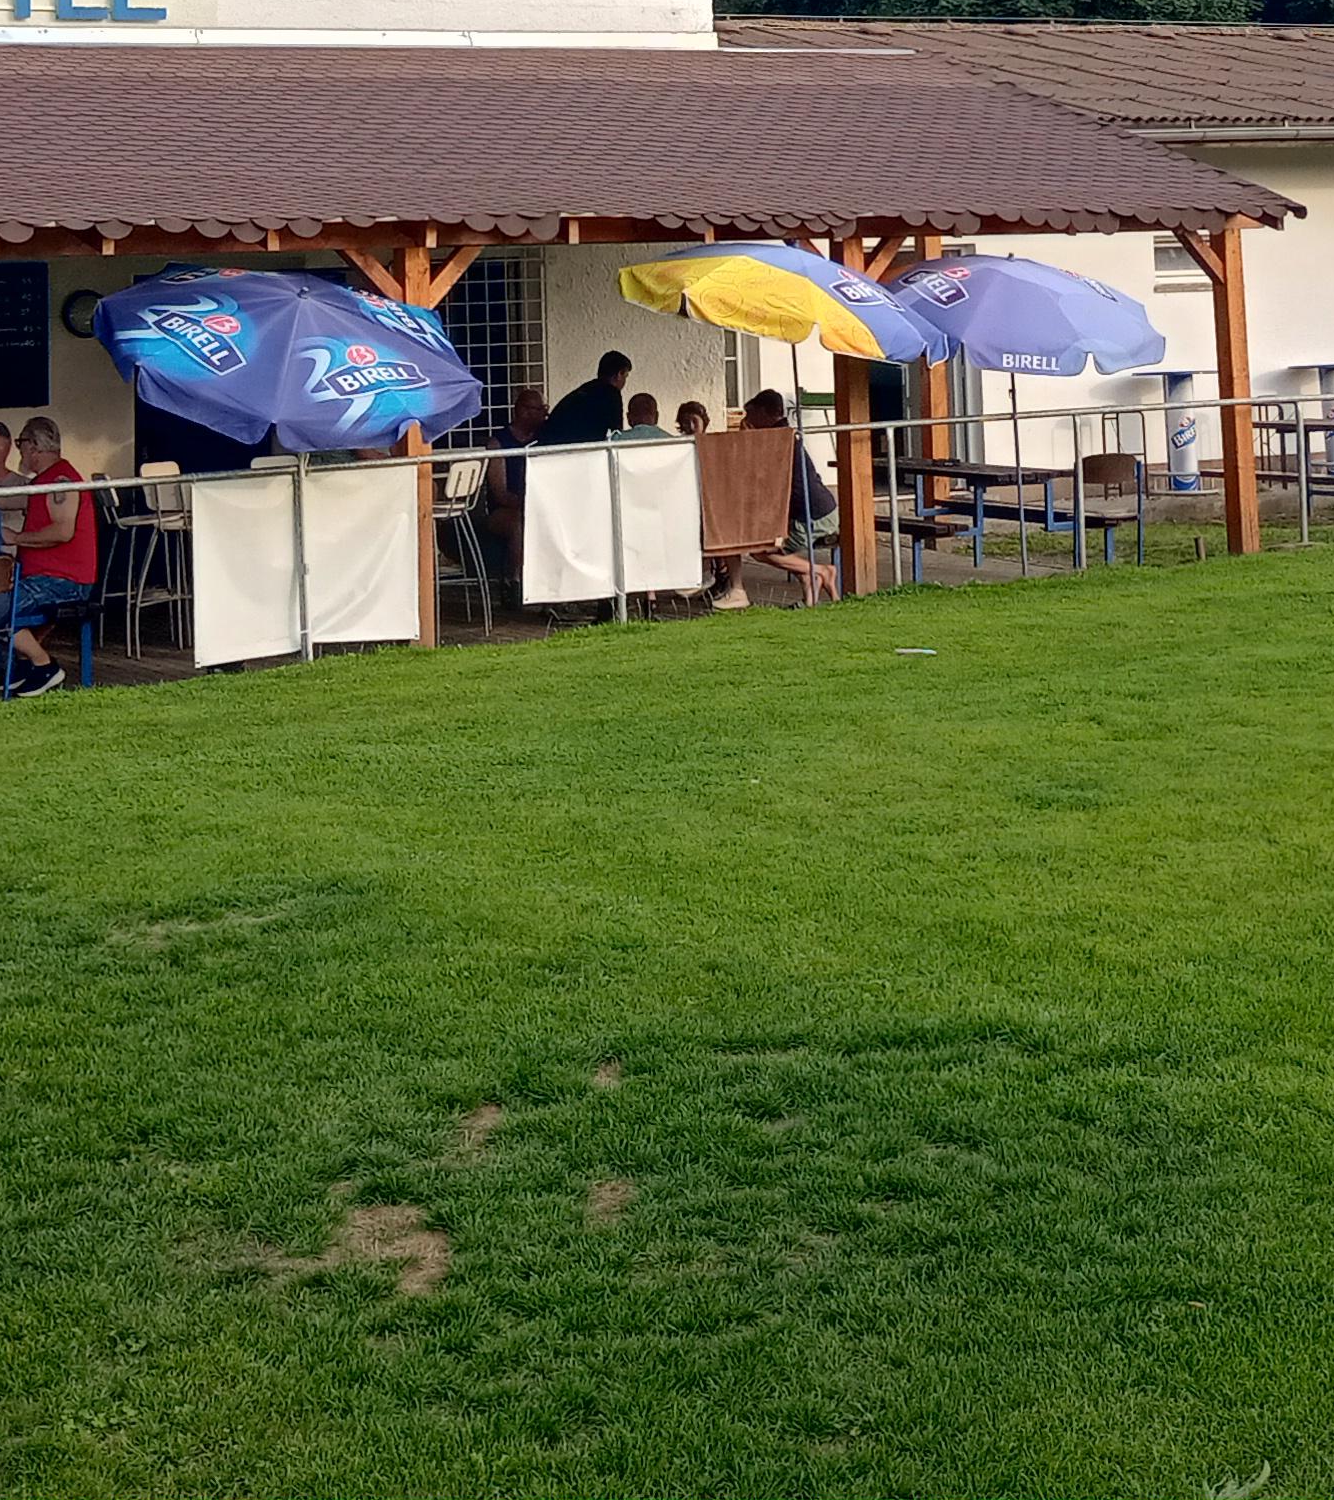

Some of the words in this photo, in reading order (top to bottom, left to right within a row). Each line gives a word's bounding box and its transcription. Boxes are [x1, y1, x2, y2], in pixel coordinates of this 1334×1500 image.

[161, 316, 230, 366] BIRELL
[1002, 352, 1061, 371] BIRELL
[336, 366, 419, 392] BIRELL
